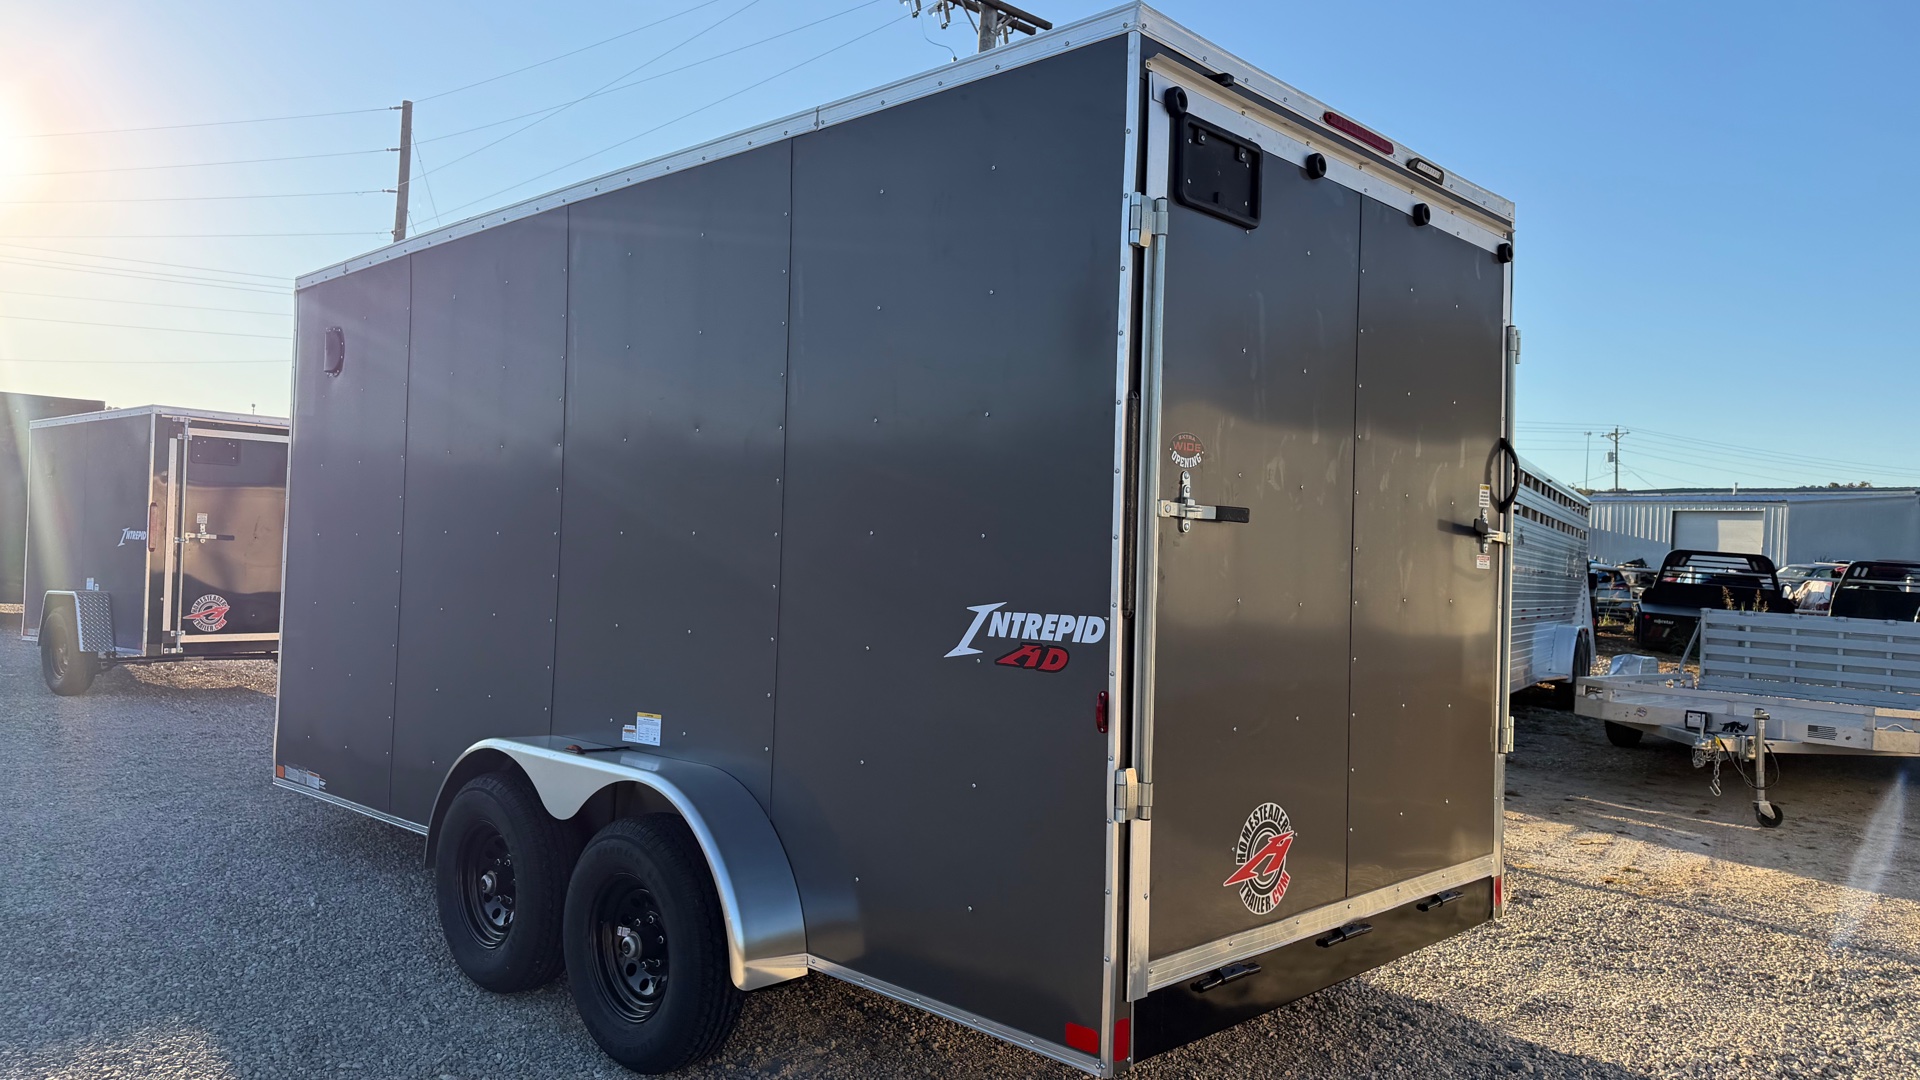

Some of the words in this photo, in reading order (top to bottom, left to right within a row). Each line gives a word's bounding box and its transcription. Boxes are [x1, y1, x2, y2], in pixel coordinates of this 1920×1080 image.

[1173, 441, 1201, 452] WIDE
[1171, 451, 1201, 468] OPENING
[117, 527, 147, 547] INTREPID
[191, 595, 227, 613] HOMESTEADER
[193, 618, 227, 631] TRAILER.COM
[943, 601, 1108, 657] INTREPID
[995, 642, 1069, 673] AD
[1237, 804, 1289, 863] HOMESTEADER
[1240, 873, 1290, 912] TRAILER.COM
